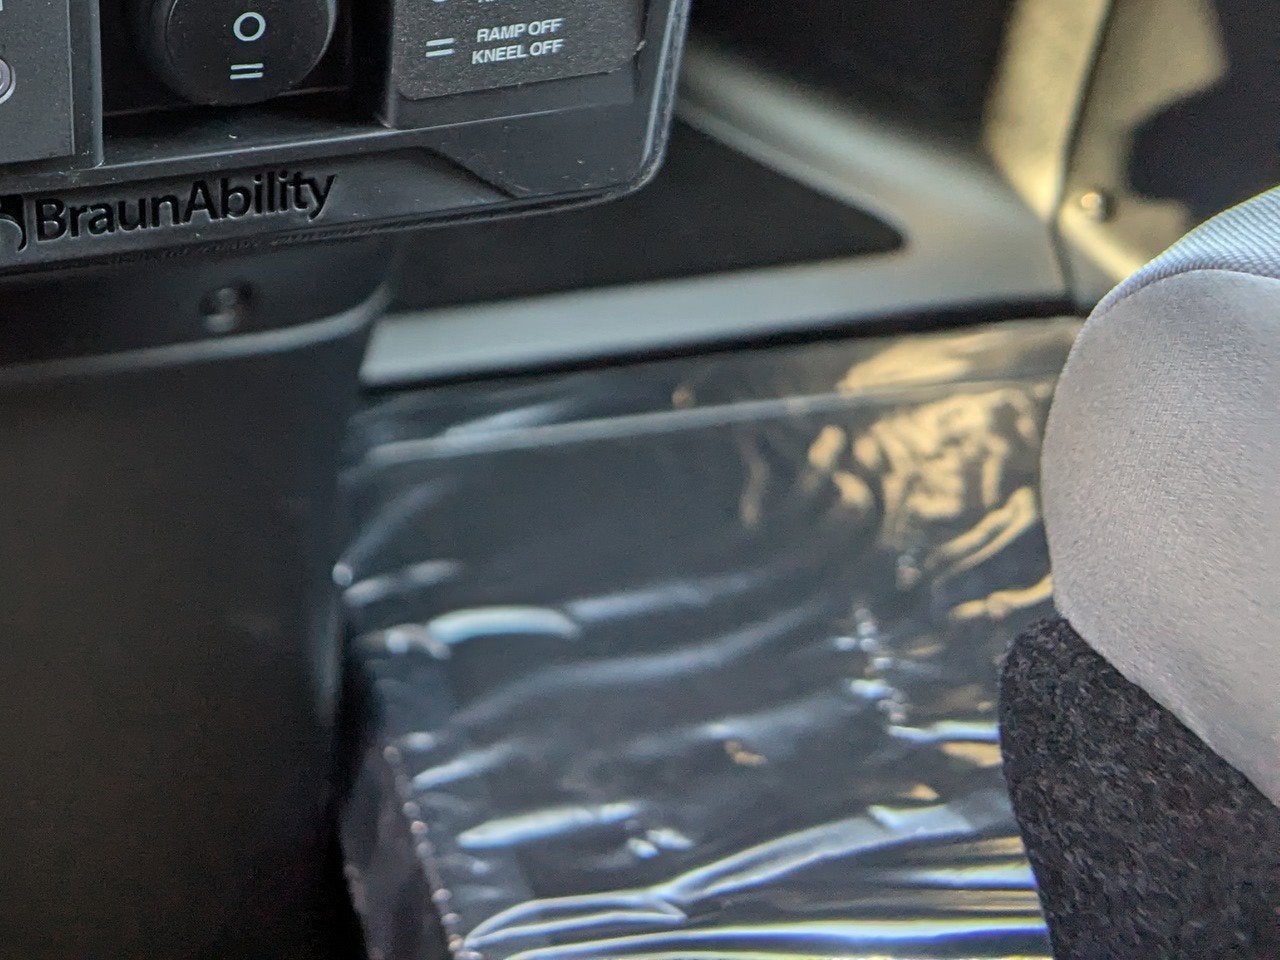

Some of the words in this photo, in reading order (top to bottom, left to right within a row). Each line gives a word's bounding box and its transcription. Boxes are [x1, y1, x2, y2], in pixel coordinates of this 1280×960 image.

[476, 23, 526, 42] RAMP
[528, 18, 564, 36] OFF
[471, 45, 527, 65] KNEEL
[529, 39, 564, 57] OFF
[34, 171, 337, 242] BraunAbility
